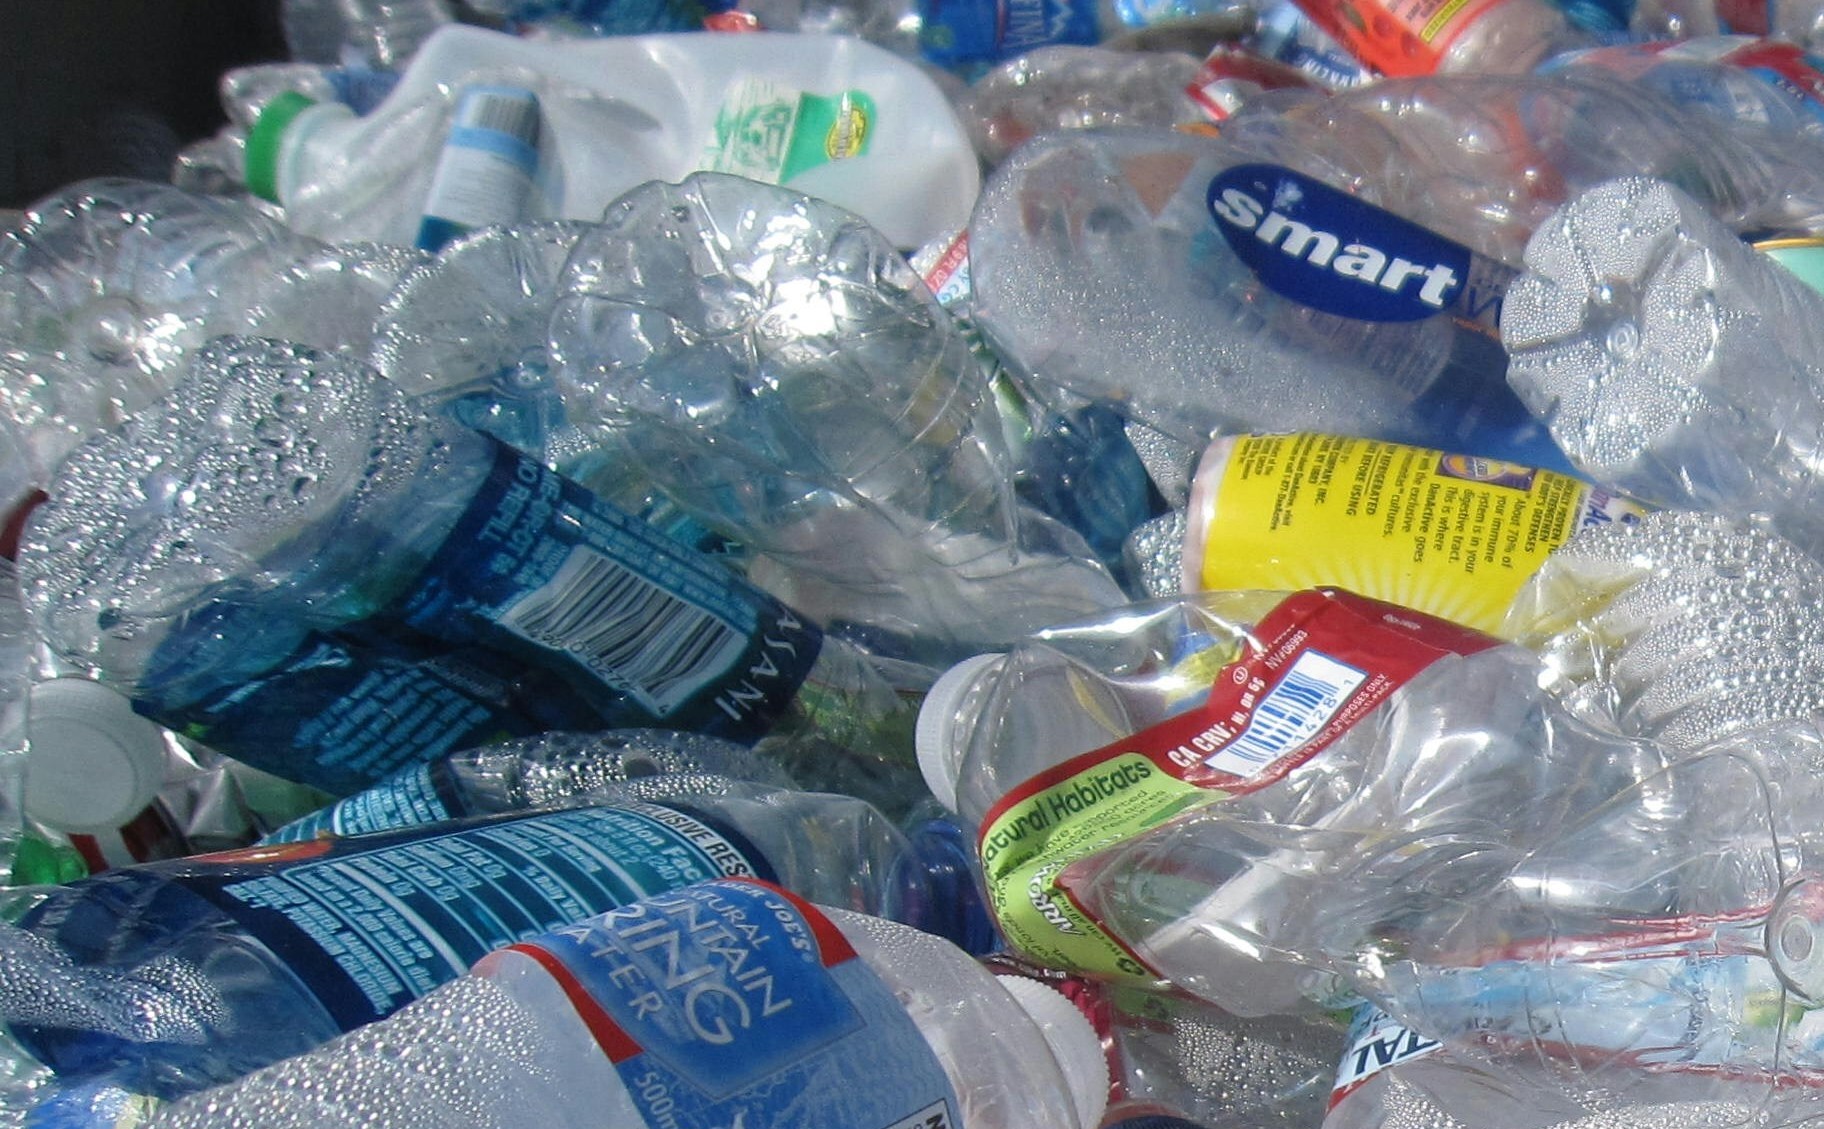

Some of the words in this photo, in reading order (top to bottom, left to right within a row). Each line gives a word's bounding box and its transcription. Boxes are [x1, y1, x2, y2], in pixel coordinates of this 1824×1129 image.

[1213, 188, 1458, 308] smart
[1346, 483, 1363, 516] USING
[1366, 454, 1391, 515] REFRIGERATED
[1442, 486, 1458, 502] This
[1382, 493, 1403, 538] cultures.
[1401, 486, 1421, 533] exclusive
[1418, 482, 1441, 533] DanActive
[1440, 505, 1452, 514] is
[1452, 488, 1475, 533] digestive
[1471, 491, 1490, 522] system
[1489, 493, 1507, 514] your
[1508, 497, 1526, 526] About
[1433, 516, 1450, 551] where
[1469, 535, 1480, 546] in
[1471, 525, 1483, 534] is
[1483, 517, 1503, 563] immune
[1503, 528, 1519, 554] 70%
[1410, 535, 1425, 563] goes
[1448, 535, 1464, 564] tract.
[1461, 548, 1476, 573] your
[1500, 555, 1513, 568] of
[1167, 746, 1193, 769] CA
[1192, 722, 1238, 755] CRV;
[1053, 761, 1152, 821] Habitats
[765, 899, 812, 953] JOE'S
